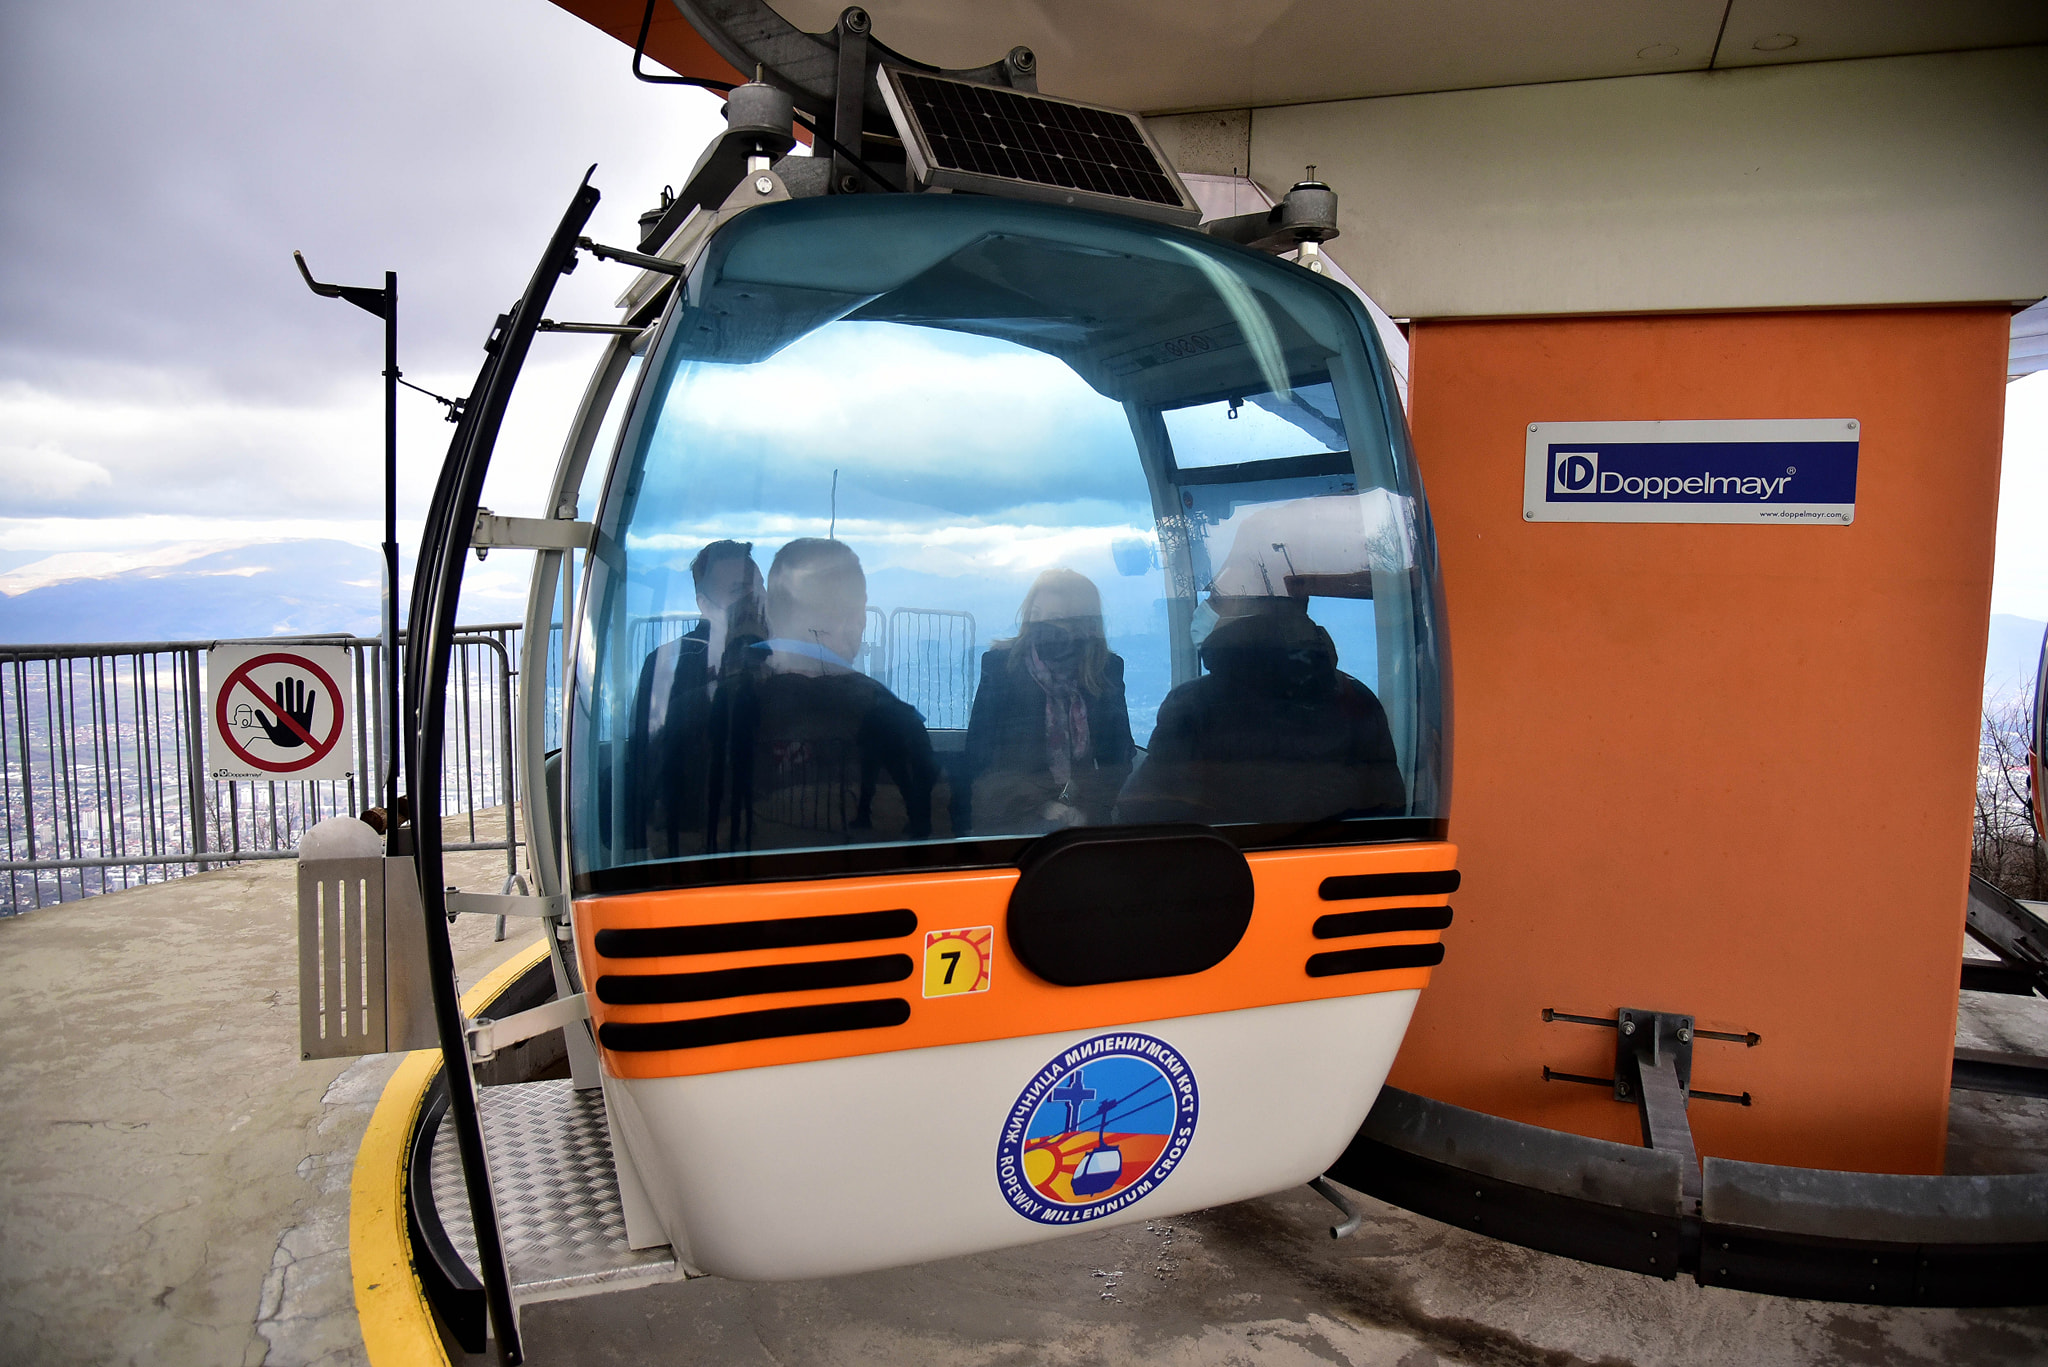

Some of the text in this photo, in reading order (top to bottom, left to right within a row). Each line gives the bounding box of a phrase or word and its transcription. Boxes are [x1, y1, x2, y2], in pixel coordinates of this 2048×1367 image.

[1759, 510, 1842, 519] www.doppelmayr.com
[941, 951, 961, 985] 7
[1005, 1036, 1194, 1144] ЖИЧНИЦА МИЛЕНИУМСКИ КРСТ
[1000, 1127, 1190, 1222] ROPEWAY MILLENNIUM CROSS
